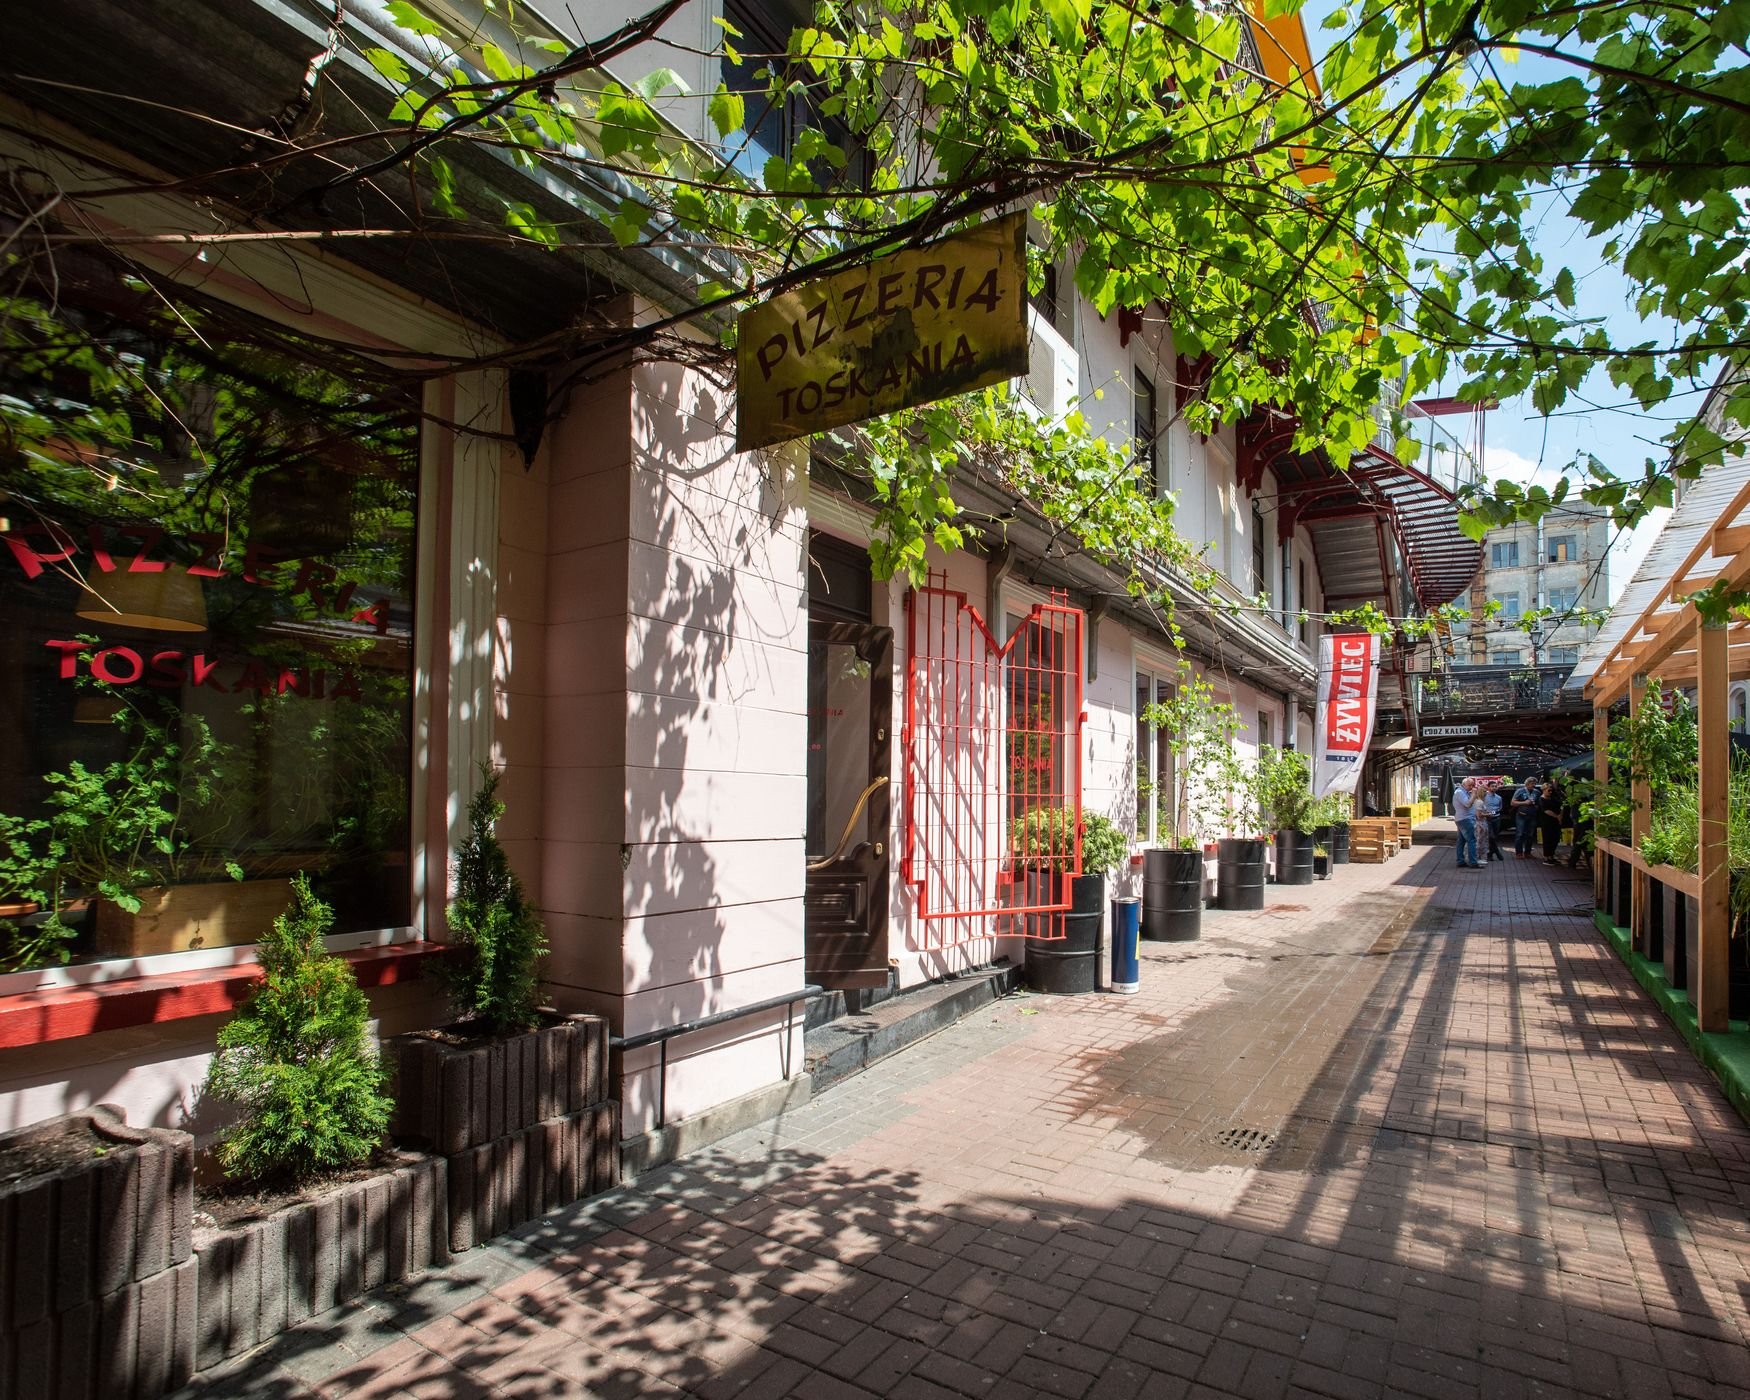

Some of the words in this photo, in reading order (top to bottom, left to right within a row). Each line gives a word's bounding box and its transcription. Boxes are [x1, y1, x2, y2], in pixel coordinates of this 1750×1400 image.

[757, 264, 1005, 381] PIZZERIA
[777, 333, 978, 420] TOSKANIA
[3, 524, 391, 635] PIZZERIA
[45, 639, 363, 701] TOSKANIA
[1331, 641, 1366, 744] ŻYWIEC
